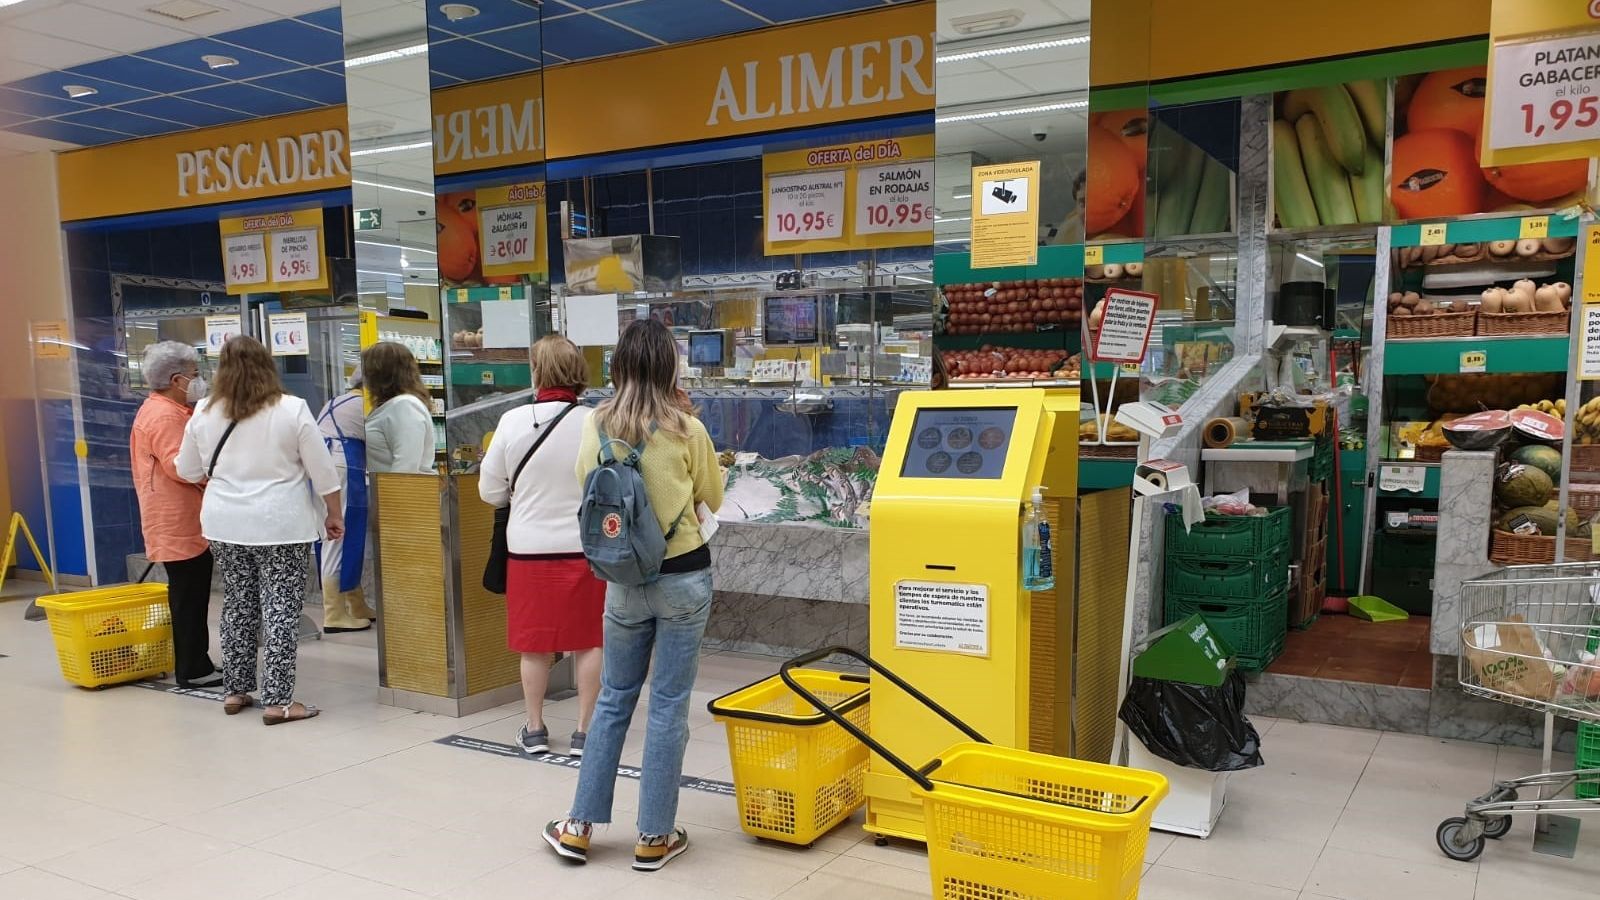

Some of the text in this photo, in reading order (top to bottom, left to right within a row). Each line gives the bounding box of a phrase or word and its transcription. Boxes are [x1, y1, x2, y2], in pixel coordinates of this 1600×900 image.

[705, 31, 936, 126] ALIMER
[1555, 84, 1590, 97] el kilo
[1521, 96, 1599, 138] 1,95
[176, 129, 349, 197] PESCADER
[808, 140, 900, 166] OFERTA del DÍA
[879, 168, 921, 182] SALMÓN
[870, 182, 929, 195] EN RODAJAS
